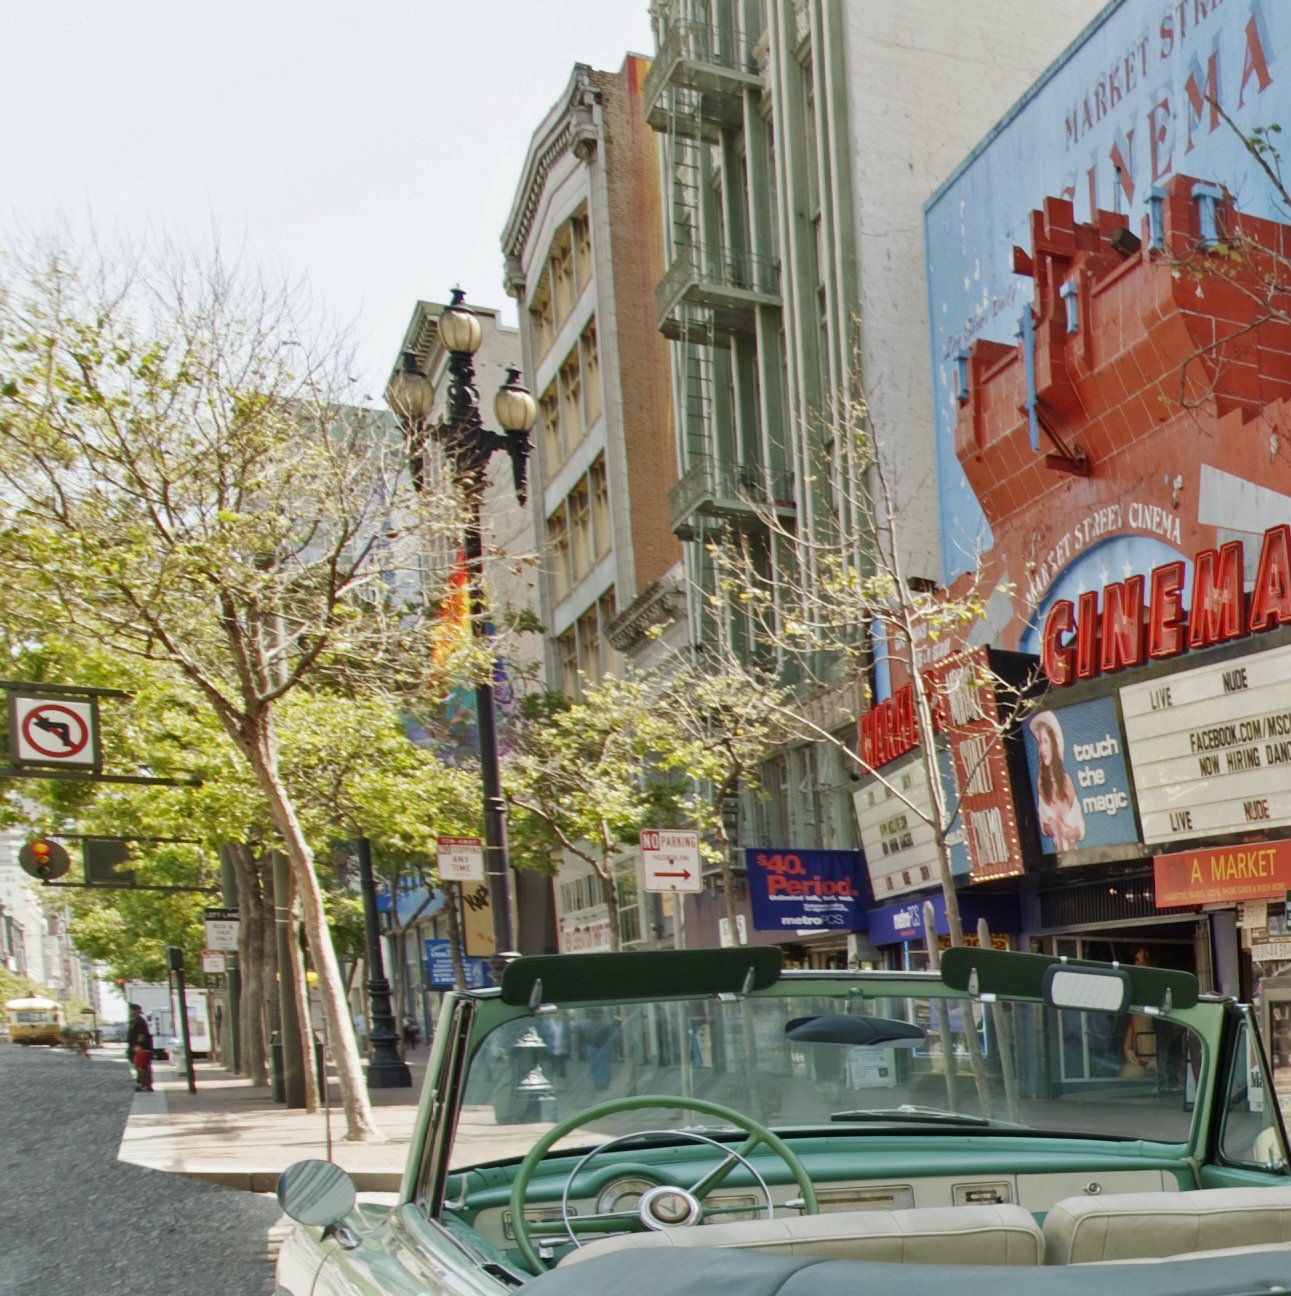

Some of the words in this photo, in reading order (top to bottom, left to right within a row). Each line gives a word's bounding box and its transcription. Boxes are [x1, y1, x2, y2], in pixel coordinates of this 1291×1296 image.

[1064, 36, 1149, 152] MARKET
[1160, 0, 1223, 59] STR
[1074, 504, 1123, 549] STREET
[1128, 502, 1182, 545] CINEMA
[1149, 687, 1173, 711] LIVE
[1222, 668, 1248, 692] NUDE
[1073, 734, 1119, 762] touch
[1199, 754, 1220, 776] NOW
[1227, 745, 1260, 771] HIRING
[1077, 765, 1106, 788] the
[1082, 789, 1128, 816] magic
[1170, 811, 1192, 832] LIVE
[1243, 799, 1270, 821] NUDE
[643, 833, 659, 849] NO
[661, 836, 696, 848] PARKING
[452, 863, 471, 872] TIME
[1191, 858, 1203, 884] A
[1211, 849, 1277, 881] MARKET
[767, 875, 858, 896] Period.
[781, 914, 844, 925] metroPCS
